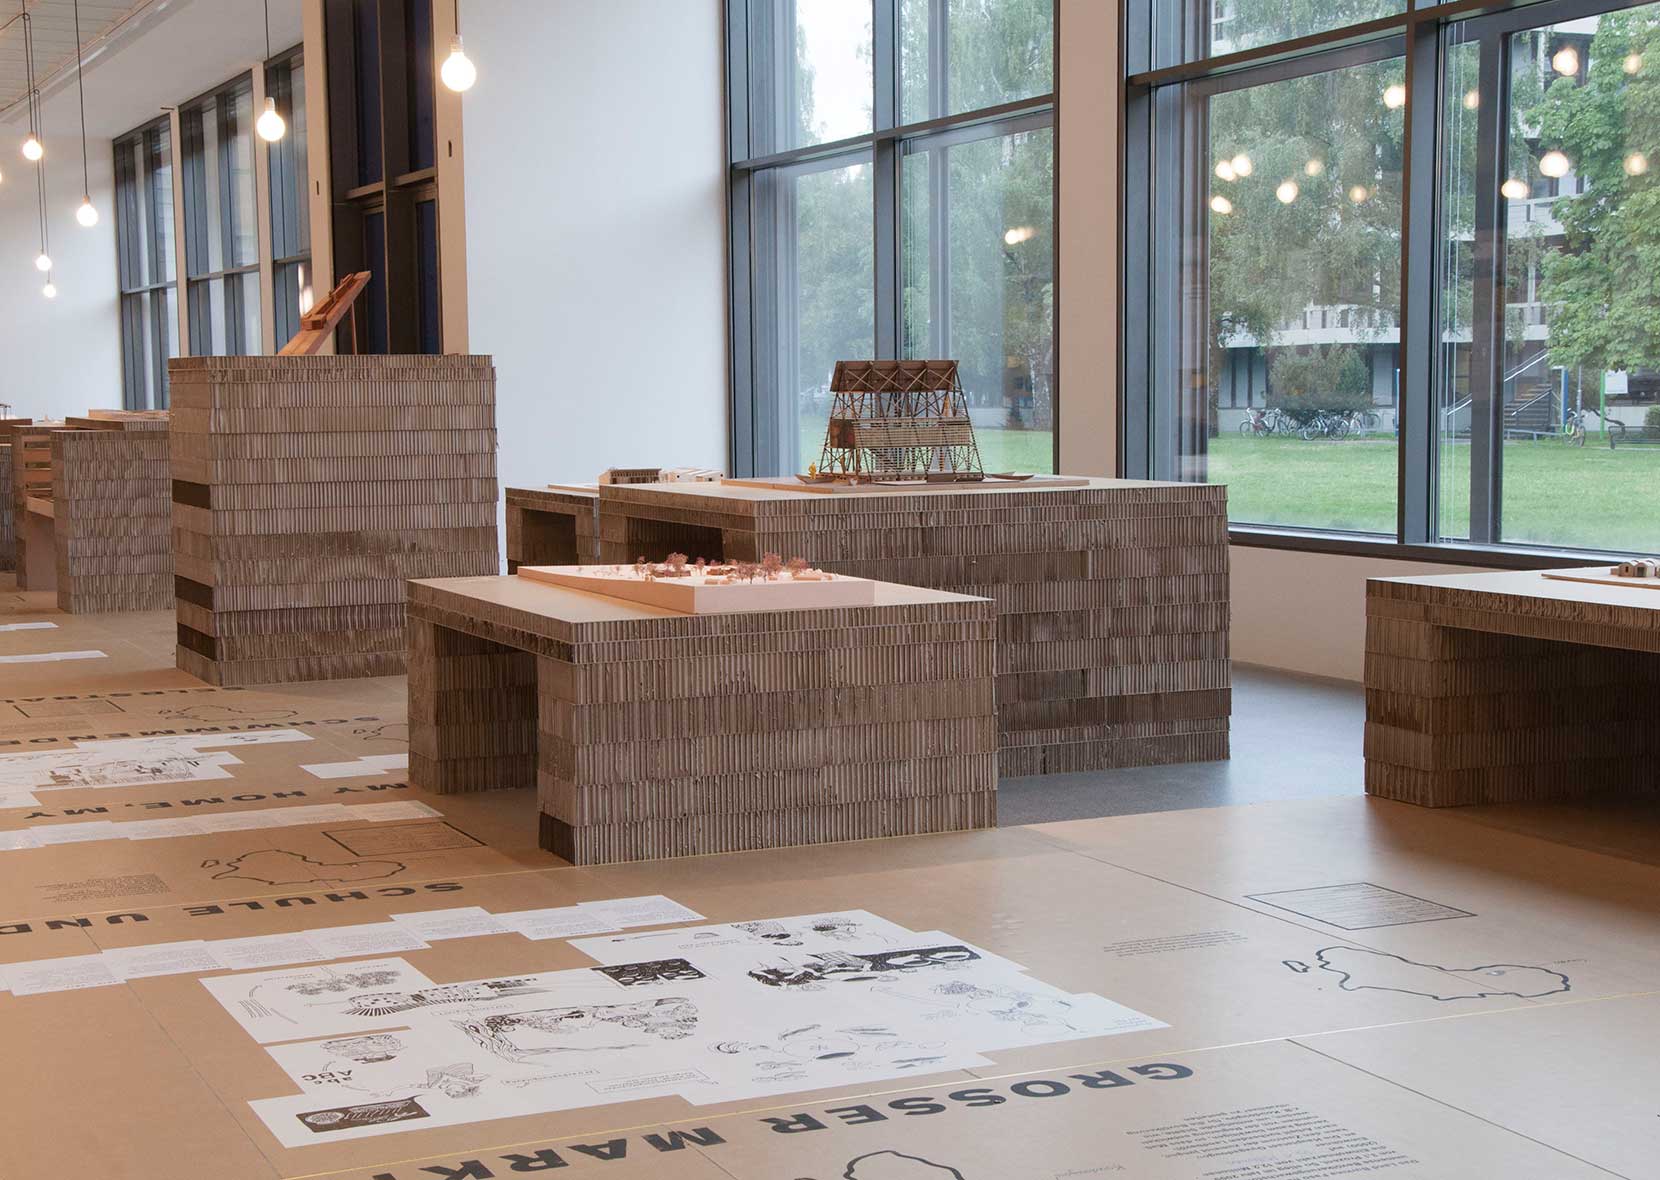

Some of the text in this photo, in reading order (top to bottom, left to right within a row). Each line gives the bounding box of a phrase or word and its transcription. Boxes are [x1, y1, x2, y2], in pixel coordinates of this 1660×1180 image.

[333, 781, 409, 795] MY
[24, 806, 109, 820] MY
[182, 882, 464, 916] SCHULE
[0, 912, 150, 935] UND
[302, 1069, 353, 1081] ABC
[371, 1062, 1195, 1180] GROSSER MARK
